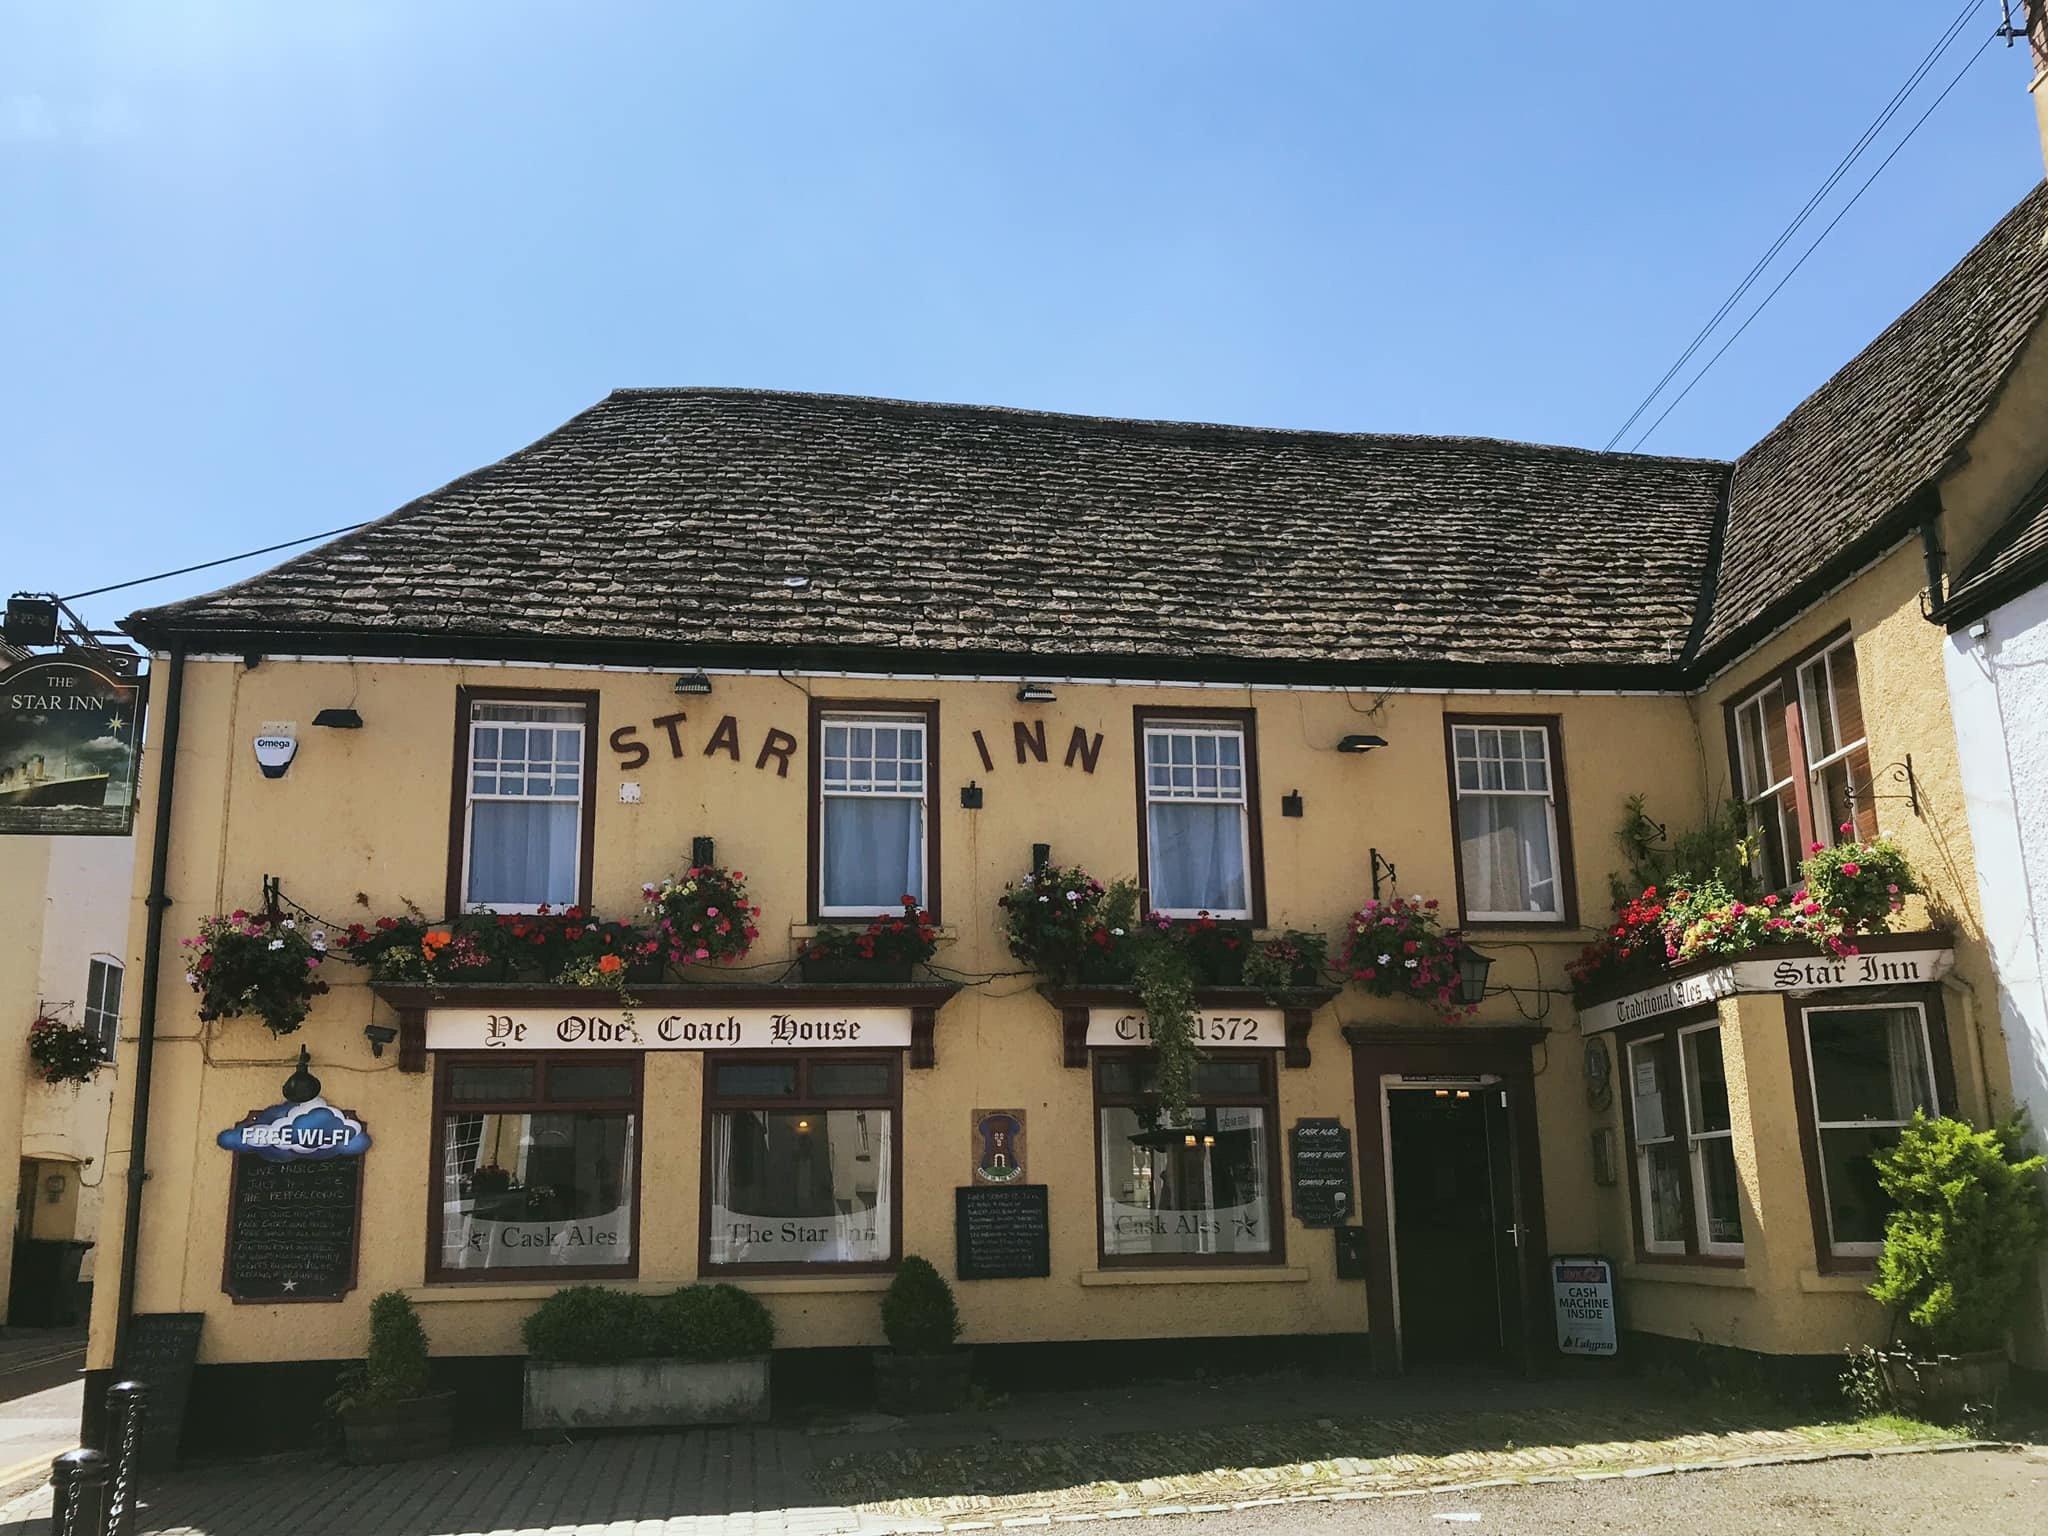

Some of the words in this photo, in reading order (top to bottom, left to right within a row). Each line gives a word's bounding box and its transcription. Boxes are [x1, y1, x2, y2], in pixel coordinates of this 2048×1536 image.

[48, 676, 73, 688] THE
[11, 694, 62, 710] STAR
[67, 695, 105, 711] INN
[257, 738, 290, 750] Omega
[608, 711, 798, 779] STAR
[972, 719, 1105, 775] INN
[1773, 960, 1847, 988] Star
[1857, 955, 1921, 983] Inn
[1615, 984, 1674, 1023] Traditional
[1674, 981, 1702, 1007] Ales
[484, 1014, 529, 1047] Ye
[555, 1014, 627, 1043] Olde
[656, 1014, 742, 1045] Coach
[769, 1013, 862, 1045] House
[1196, 1017, 1259, 1042] 1572
[241, 1127, 293, 1145] FREE
[297, 1128, 350, 1146] WI-FI
[727, 1222, 774, 1243] The
[780, 1221, 829, 1243] Star
[1115, 1214, 1168, 1235] Cask
[1173, 1214, 1222, 1235] Ales
[501, 1226, 559, 1248] Cask
[567, 1225, 618, 1247] Ales
[1568, 1287, 1598, 1298] CASH
[1559, 1298, 1609, 1309] MACHINE
[1567, 1309, 1604, 1320] INSIDE
